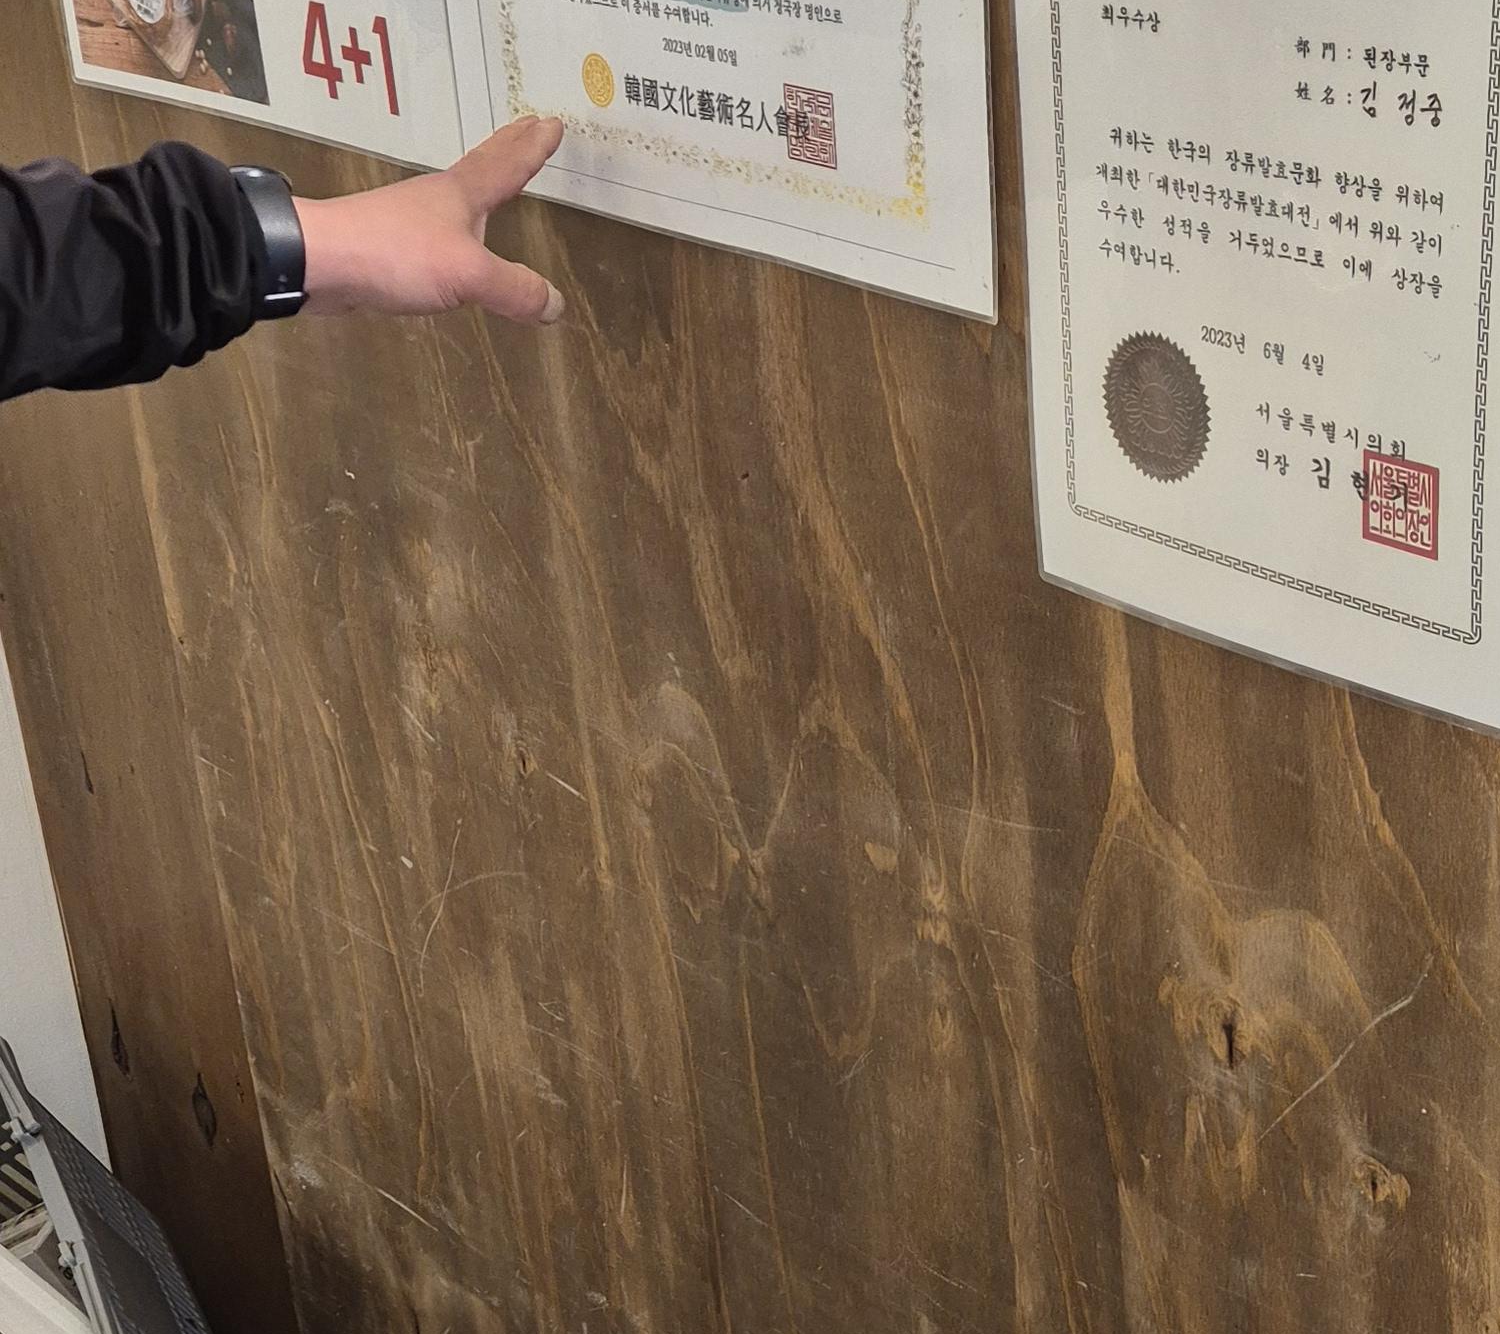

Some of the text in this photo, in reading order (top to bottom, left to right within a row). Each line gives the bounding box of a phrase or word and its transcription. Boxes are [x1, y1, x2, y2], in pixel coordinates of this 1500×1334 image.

[1102, 4, 1160, 32] 최우수상
[302, 0, 400, 116] 4+1
[662, 37, 738, 67] 2023년 02월 05일
[1363, 47, 1429, 77] 된장부문
[1361, 81, 1376, 118] 김
[1110, 127, 1443, 215] 귀하는 한국의 장류발효문화 향상을 위하여
[1095, 162, 1141, 189] 개최한
[1369, 217, 1403, 247] 위와
[1410, 230, 1444, 257] 같이
[1098, 200, 1442, 298] 우수한 성적을 거두었으므로 이에 상장을
[1099, 239, 1179, 273] 수여합니다.
[1202, 326, 1323, 376] 2023년 6월 4일
[1255, 447, 1333, 490] 의장 김
